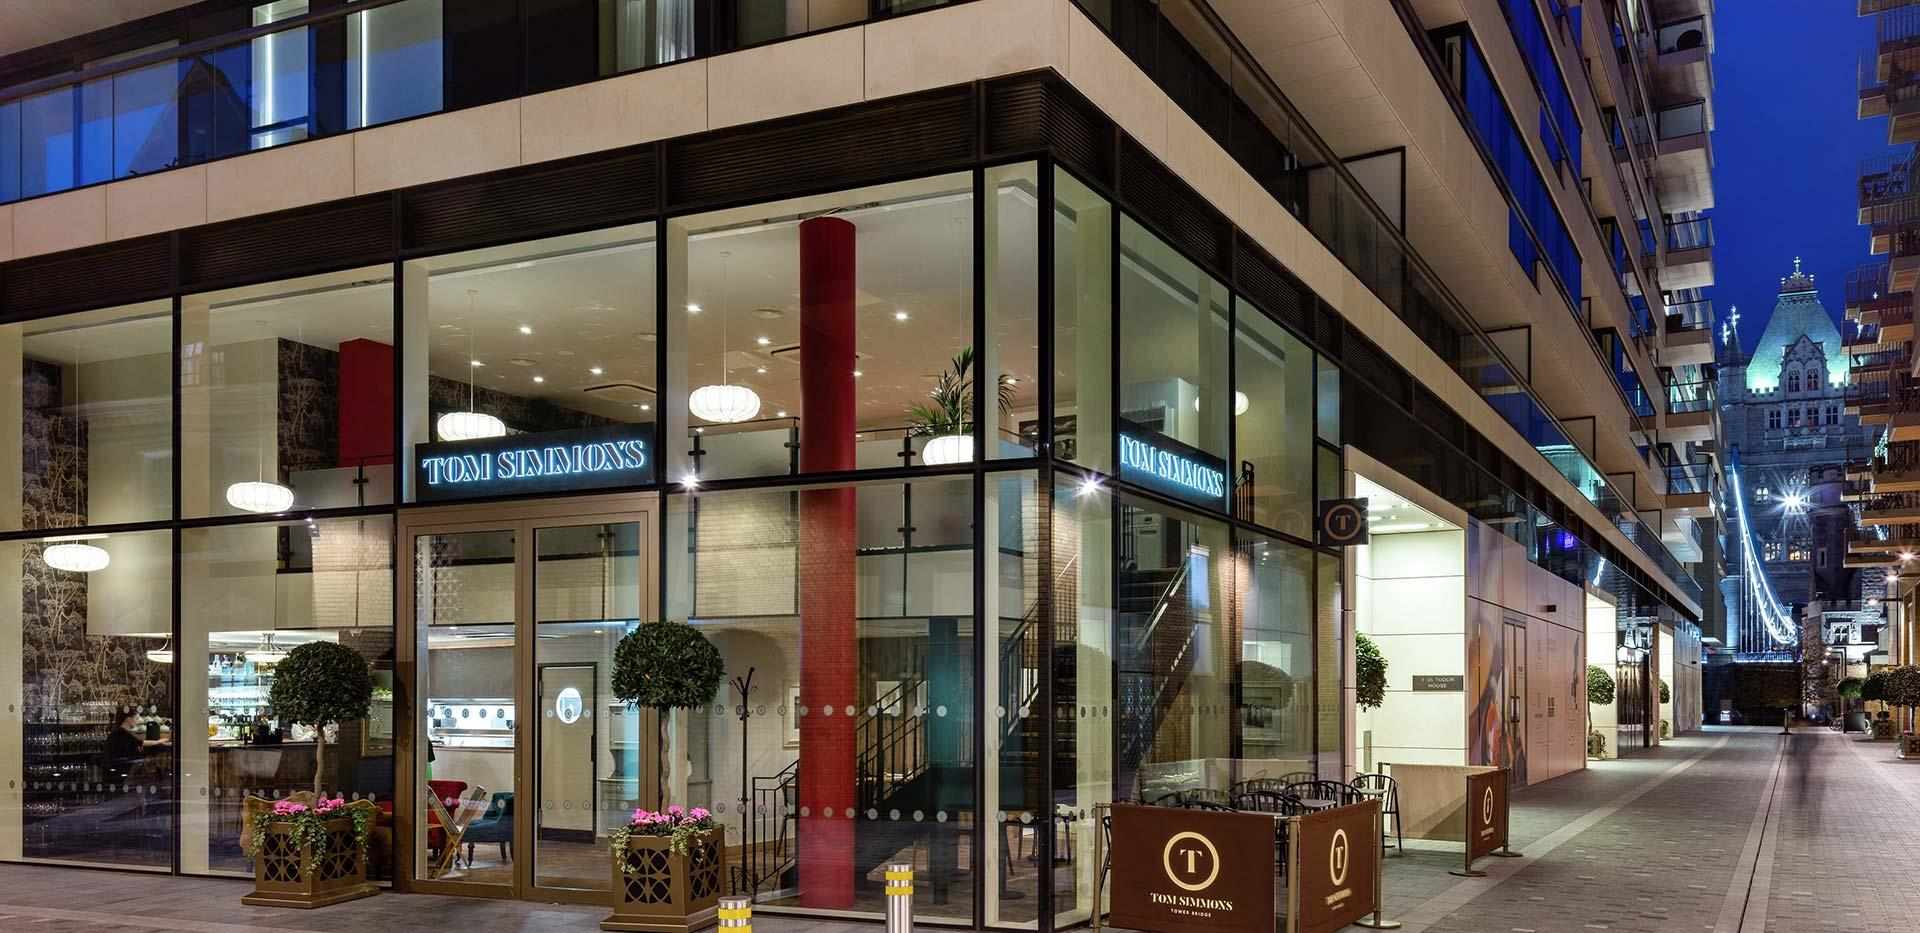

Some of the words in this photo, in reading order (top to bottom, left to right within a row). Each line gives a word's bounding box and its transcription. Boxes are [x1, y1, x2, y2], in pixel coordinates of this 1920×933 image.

[423, 453, 490, 484] TOM
[497, 440, 644, 478] SIMMONS
[1120, 433, 1156, 474] TOM
[1159, 450, 1224, 498] SIMMONS
[1335, 514, 1351, 530] T
[1180, 849, 1203, 873] T
[1335, 846, 1344, 869] T
[1150, 892, 1177, 905] TOM
[1179, 896, 1233, 911] SIMMONS
